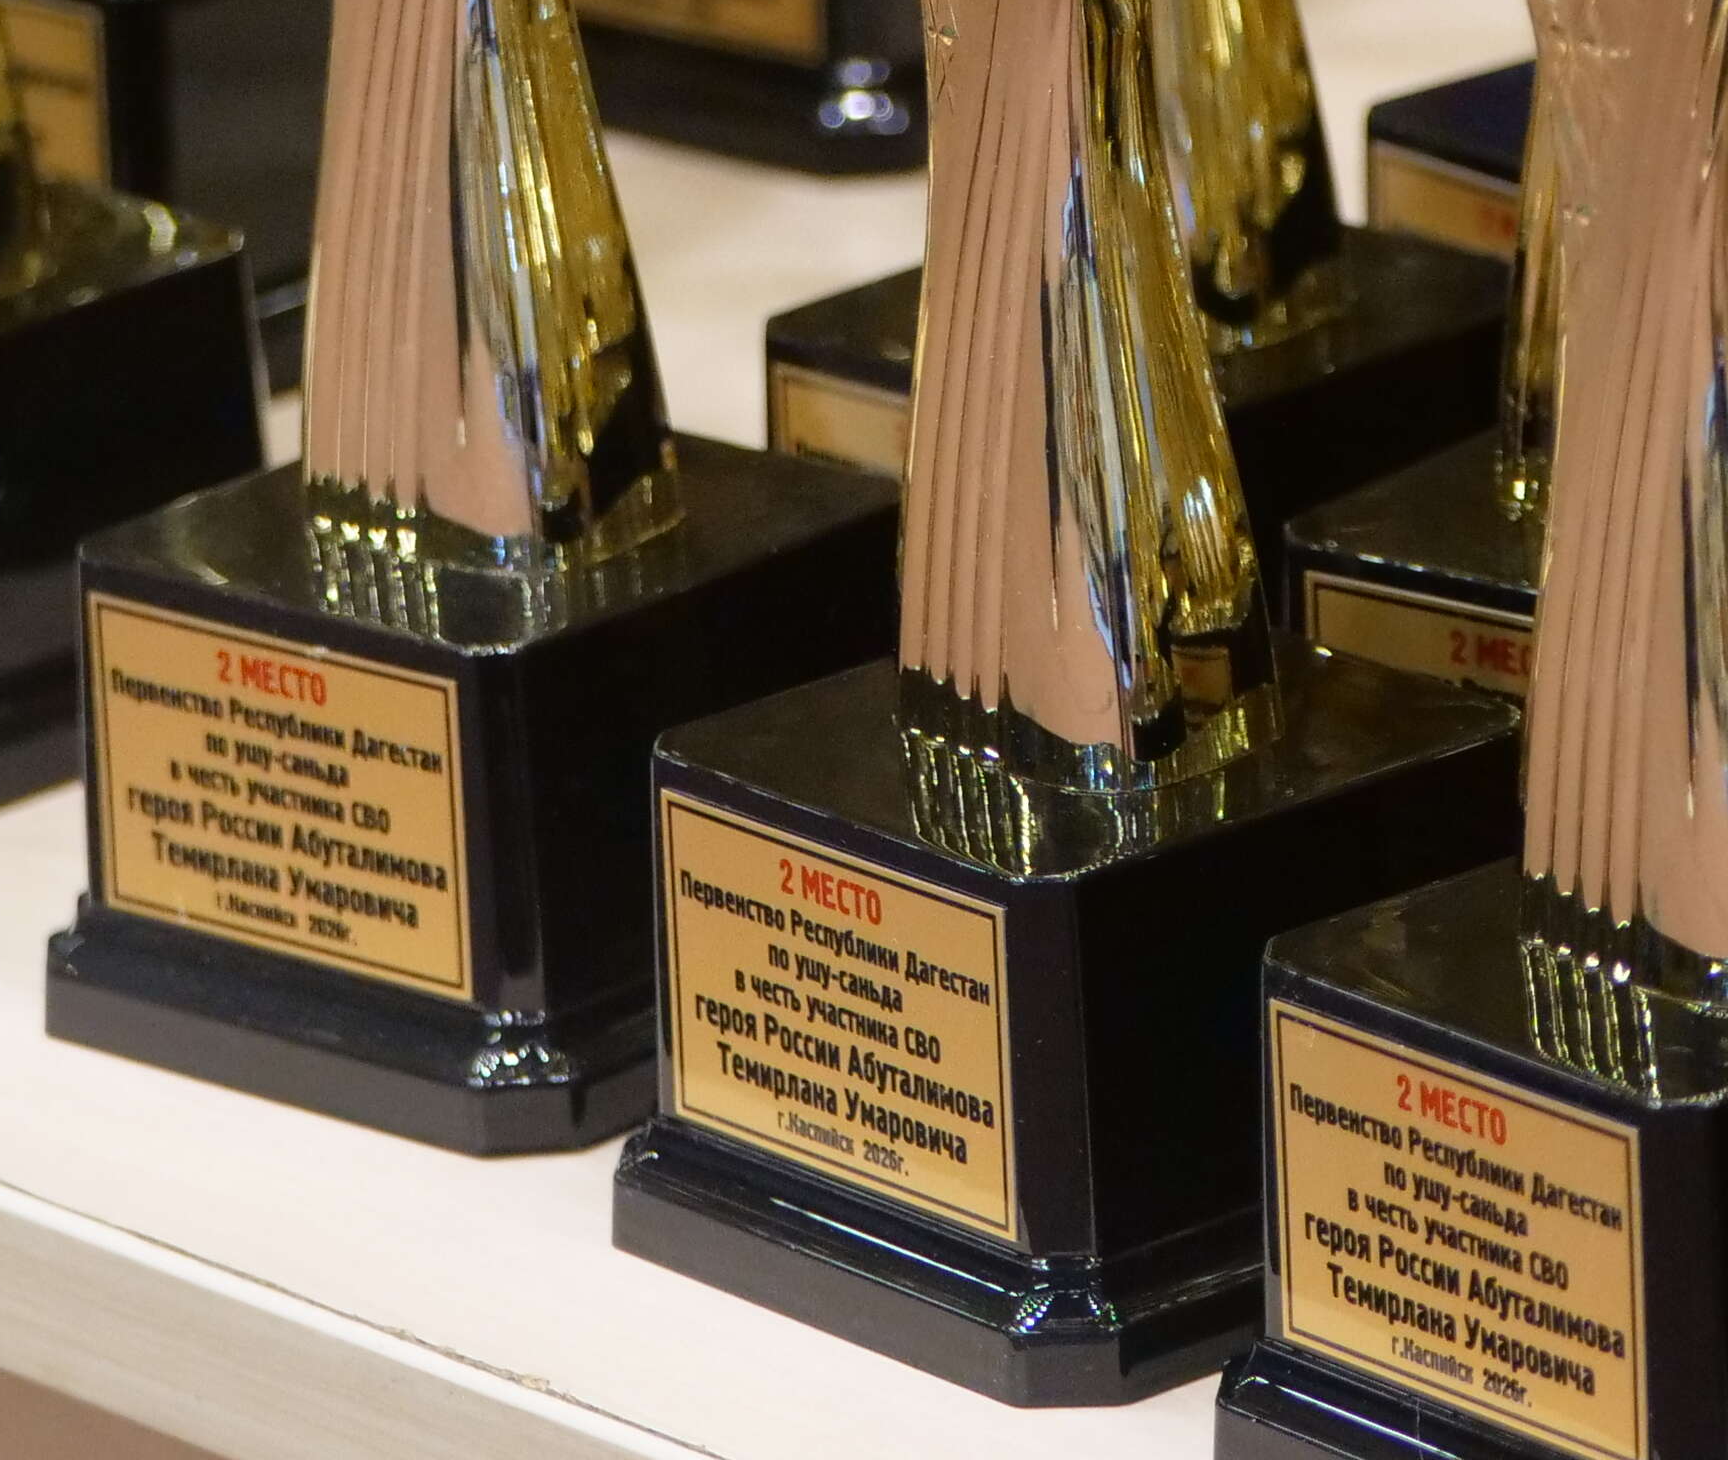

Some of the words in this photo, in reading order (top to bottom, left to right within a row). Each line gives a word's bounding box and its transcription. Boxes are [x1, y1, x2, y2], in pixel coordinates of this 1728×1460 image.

[216, 649, 232, 684] 2
[239, 655, 326, 706] МЕСТО
[1477, 635, 1530, 676] МЕС
[111, 668, 223, 719] Первенство
[228, 697, 345, 748] Республики
[351, 728, 442, 773] Дагестан
[204, 732, 228, 757] по
[234, 740, 349, 788] ушу-саньда
[127, 787, 193, 825] героя
[200, 800, 283, 848] России
[291, 824, 447, 891] Абуталимова
[187, 764, 240, 796] честь
[247, 779, 344, 823] участника
[350, 801, 390, 834] СВО
[151, 830, 279, 892] Темирлана
[288, 867, 418, 928] Умаровича
[779, 858, 794, 894] 2
[800, 865, 881, 924] МЕСТО
[680, 869, 785, 930] Первенство
[790, 909, 898, 972] Республики
[904, 951, 989, 1005] Дагестан
[767, 943, 789, 970] по
[794, 954, 902, 1012] ушу-саньда
[695, 994, 757, 1040] героя
[763, 1013, 840, 1071] России
[848, 1045, 993, 1127] Абуталимова
[734, 969, 745, 992] в
[750, 975, 801, 1012] честь
[806, 995, 898, 1048] участника
[903, 1026, 940, 1064] СВО
[717, 1041, 837, 1115] Темирлана
[844, 1088, 966, 1163] Умаровича
[777, 1111, 854, 1155] г.Каспийск
[862, 1139, 908, 1175] 2026г.
[1396, 1073, 1412, 1111] 2
[1419, 1082, 1506, 1145] МЕСТО
[1290, 1083, 1402, 1149] Первенство
[1408, 1126, 1524, 1194] Республики
[1530, 1172, 1622, 1230] Дагестан
[1383, 1161, 1406, 1191] по
[1412, 1173, 1527, 1236] ушу-саньда
[1304, 1212, 1370, 1262] героя
[1378, 1234, 1460, 1295] России
[1468, 1270, 1624, 1357] Абуталимова
[1347, 1187, 1359, 1212] в
[1364, 1194, 1418, 1234] честь
[1424, 1216, 1522, 1273] участника
[1528, 1251, 1568, 1290] СВО
[1327, 1262, 1456, 1341] Темирлана
[1464, 1315, 1594, 1395] Умаровича
[1391, 1336, 1473, 1383] г.Каспийск
